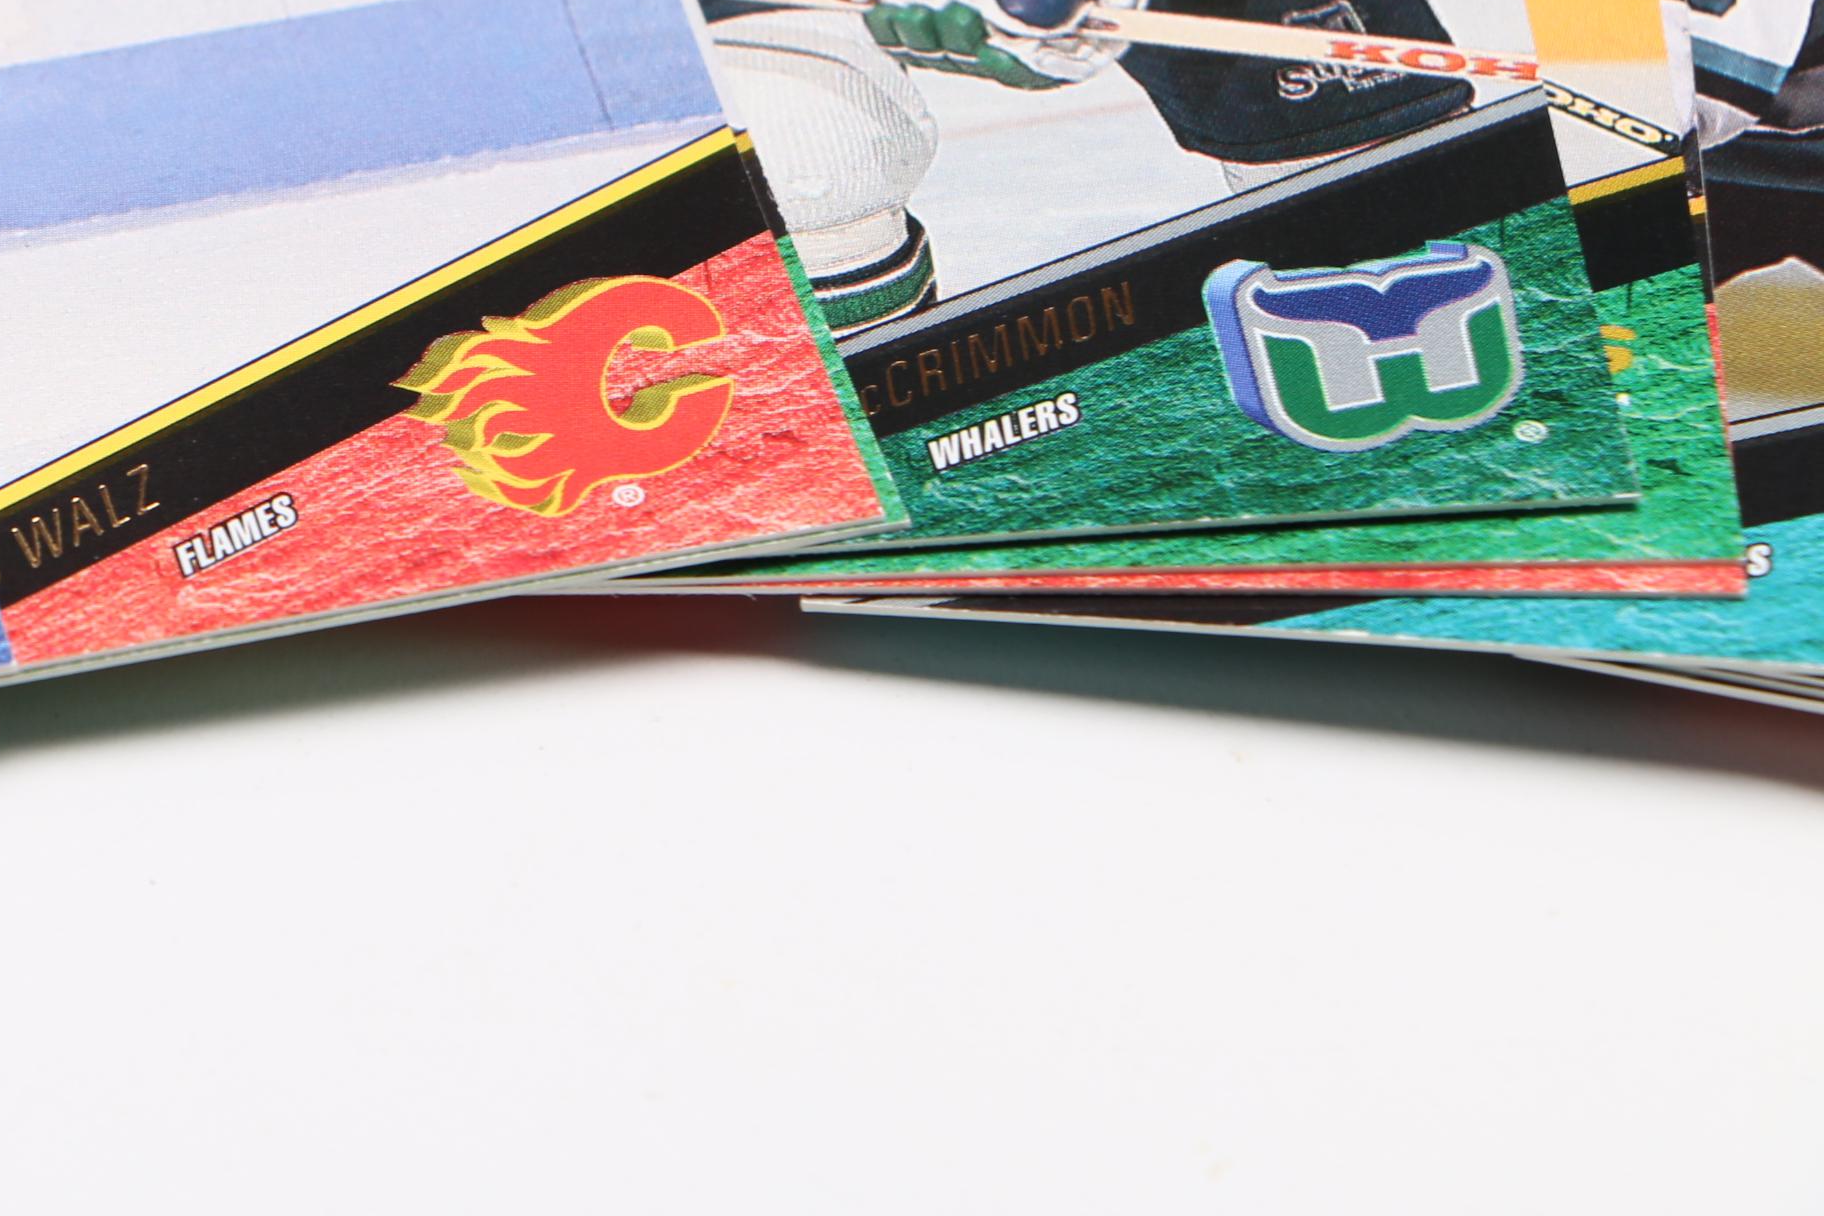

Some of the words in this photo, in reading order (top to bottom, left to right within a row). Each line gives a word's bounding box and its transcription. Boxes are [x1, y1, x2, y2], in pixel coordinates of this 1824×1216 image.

[1327, 39, 1539, 82] KOH
[927, 392, 1080, 471] WHALERS
[9, 463, 160, 569] WALZ
[175, 492, 299, 579] FLAMES
